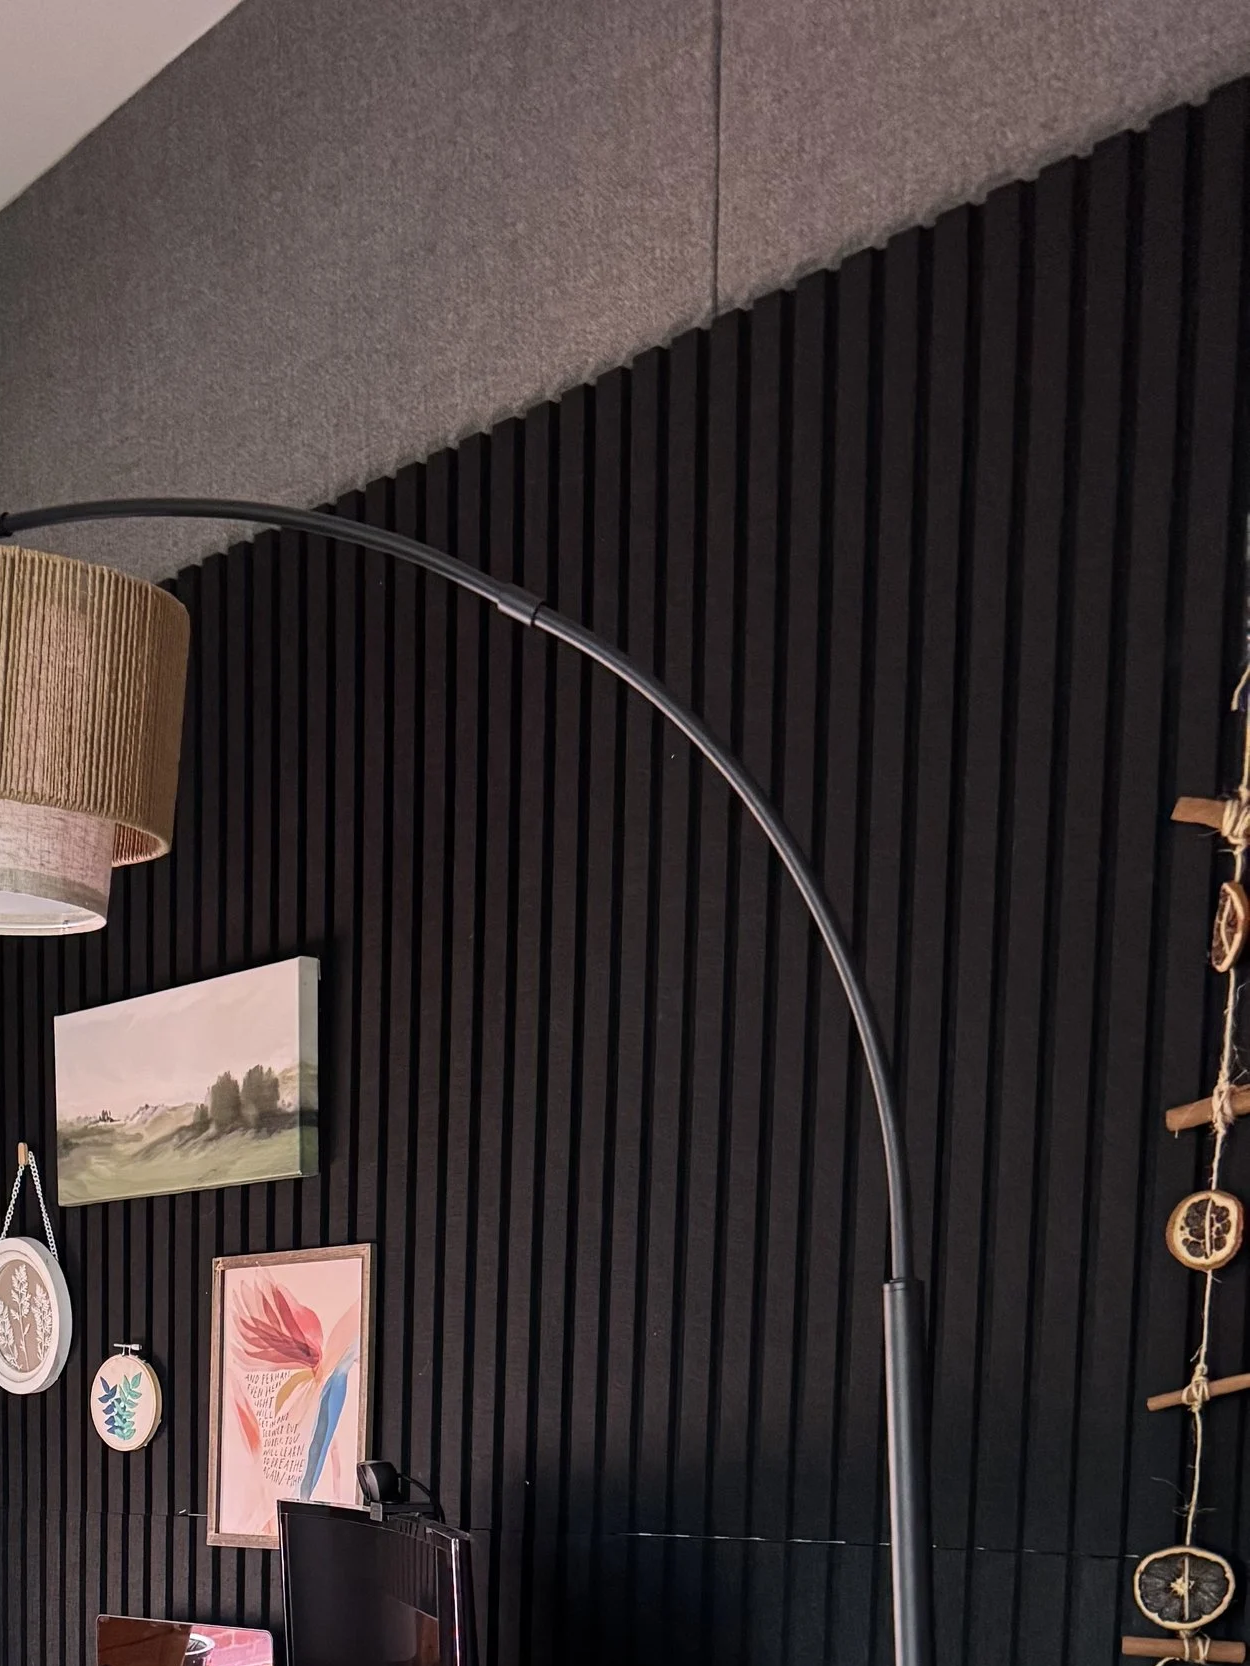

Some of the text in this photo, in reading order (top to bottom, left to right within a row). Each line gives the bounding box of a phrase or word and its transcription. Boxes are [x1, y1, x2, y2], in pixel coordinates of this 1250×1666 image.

[245, 1373, 260, 1385] AND
[256, 1409, 273, 1420] WILL
[263, 1443, 305, 1458] WILL LEARN
[270, 1457, 306, 1473] BREATHE
